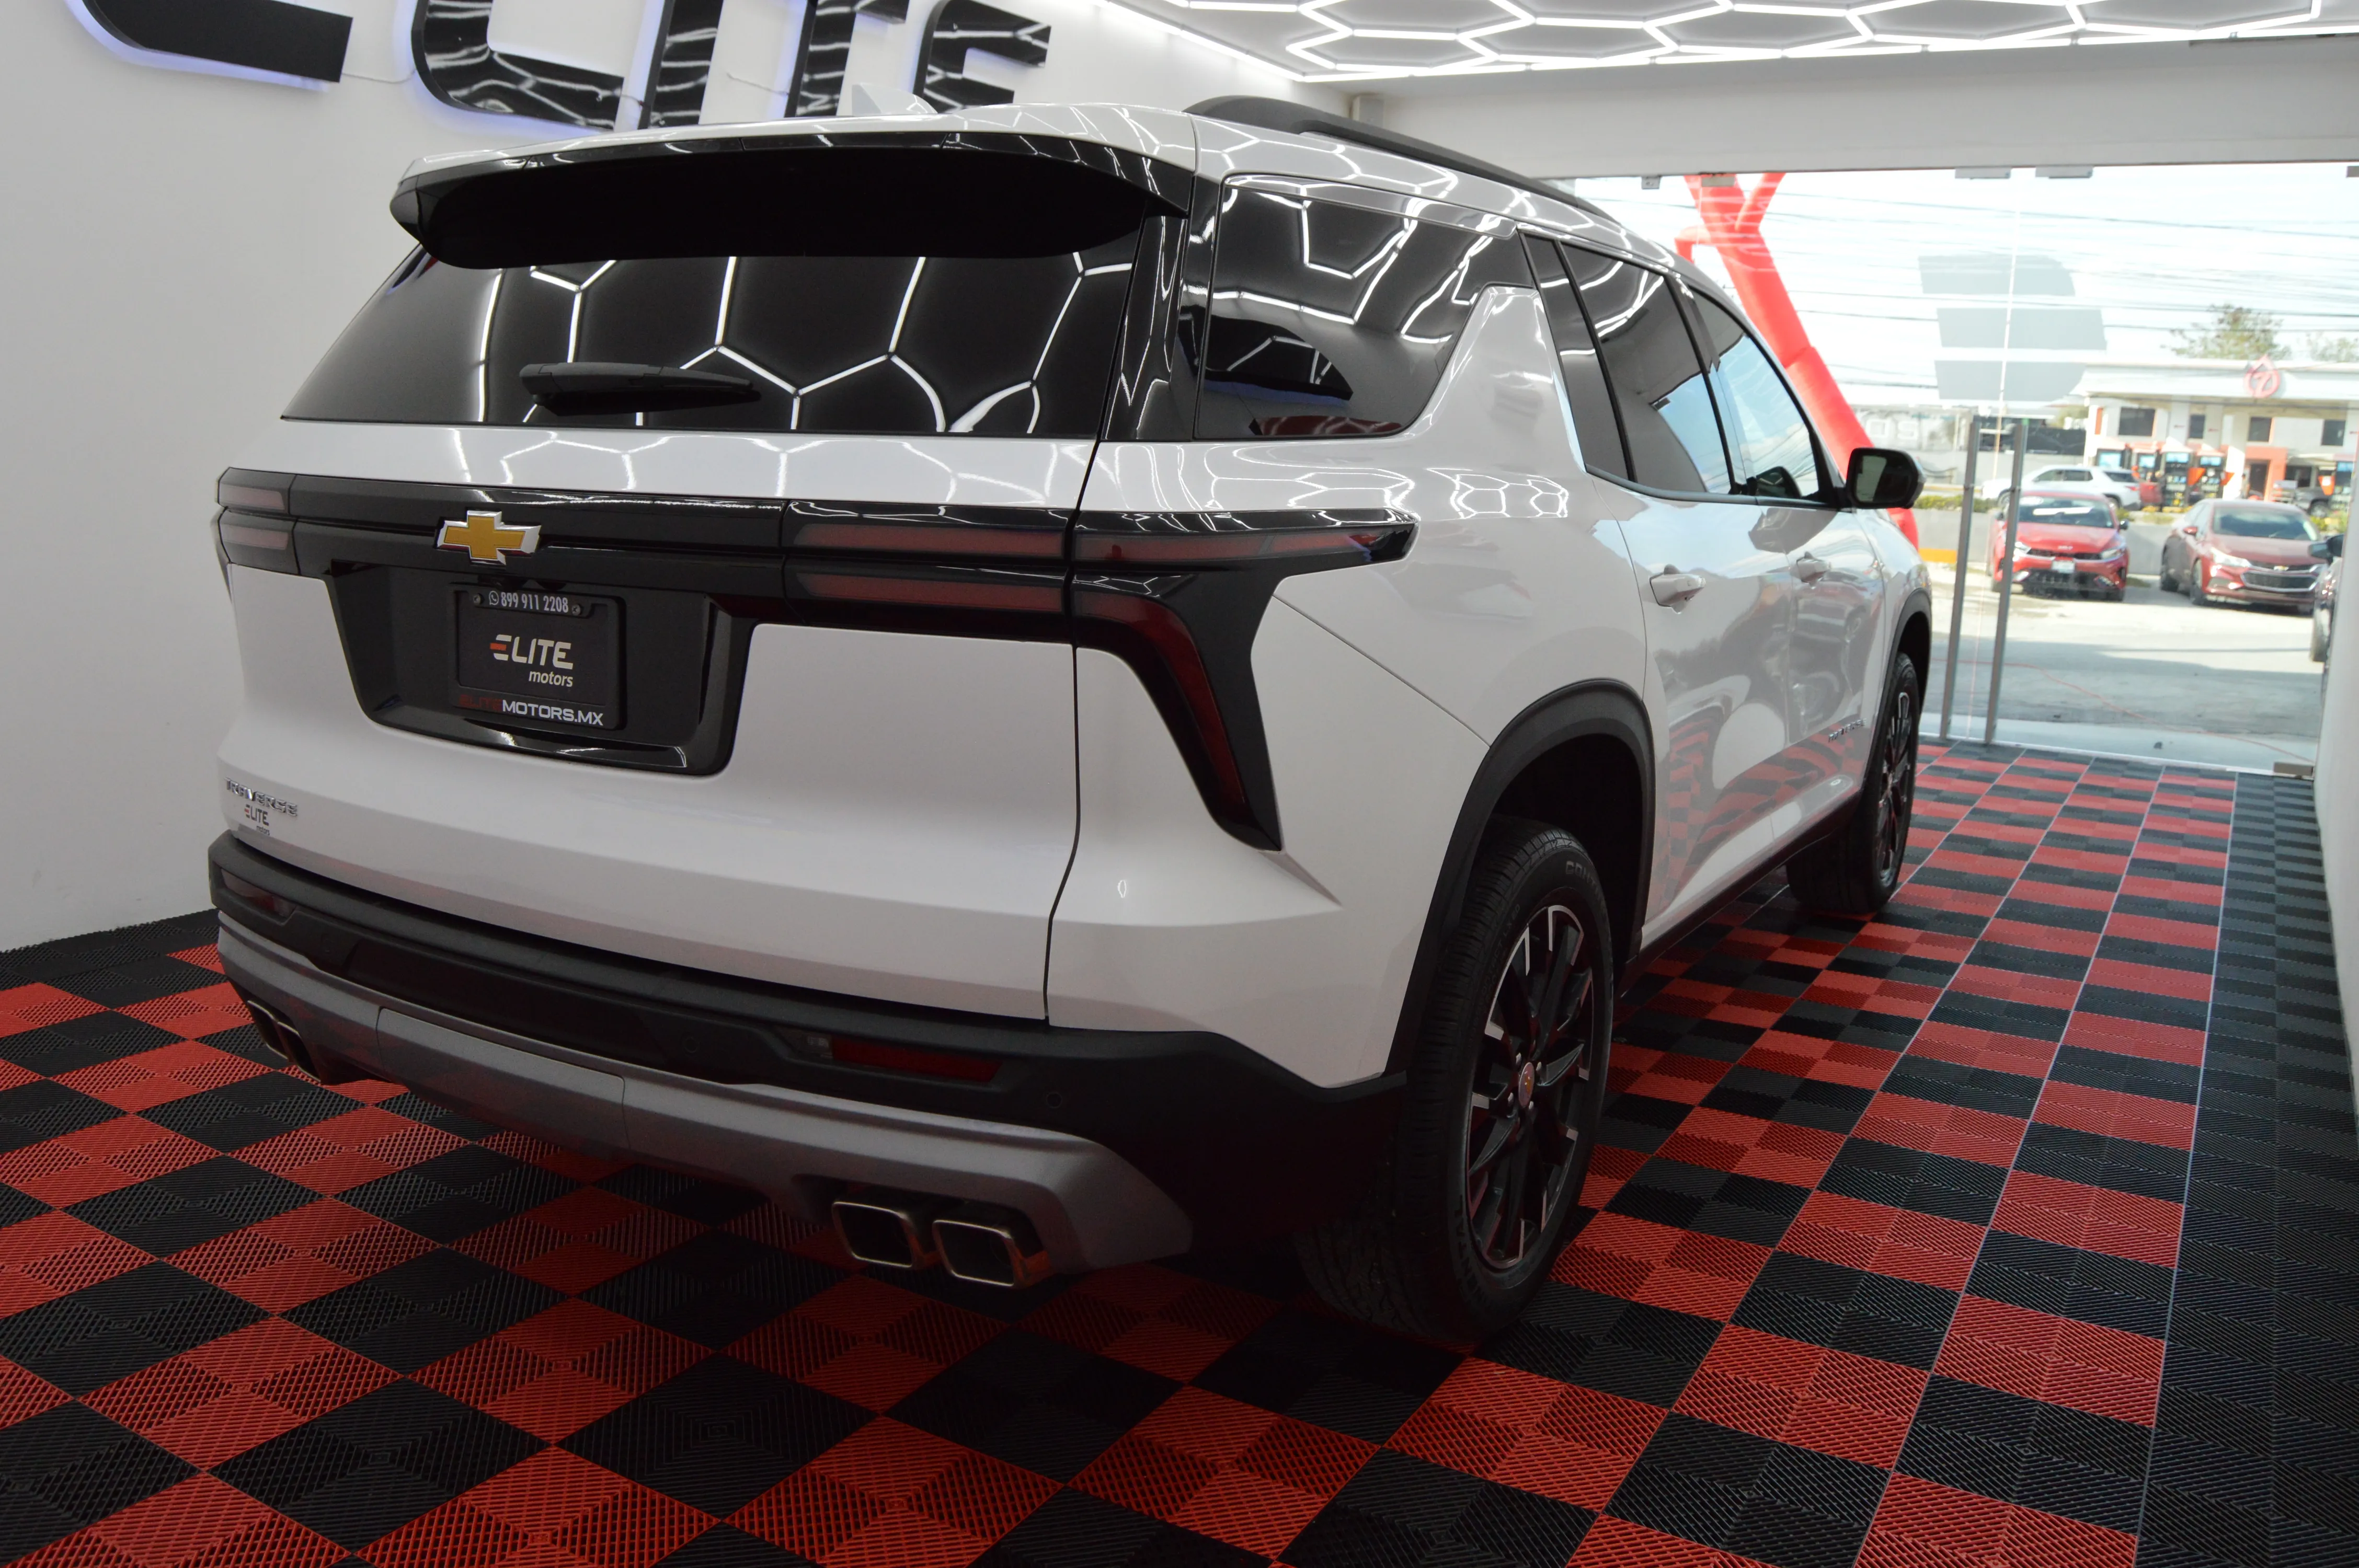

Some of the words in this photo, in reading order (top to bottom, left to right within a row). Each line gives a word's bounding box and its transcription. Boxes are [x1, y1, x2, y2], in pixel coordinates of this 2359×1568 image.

[500, 592, 518, 607] 899
[521, 594, 540, 610] 911
[544, 596, 569, 613] 2208
[489, 634, 574, 670] ELITE
[529, 671, 573, 687] motors
[225, 777, 297, 816] TRAVERSE
[244, 803, 269, 826] ELITE
[256, 825, 270, 836] motors
